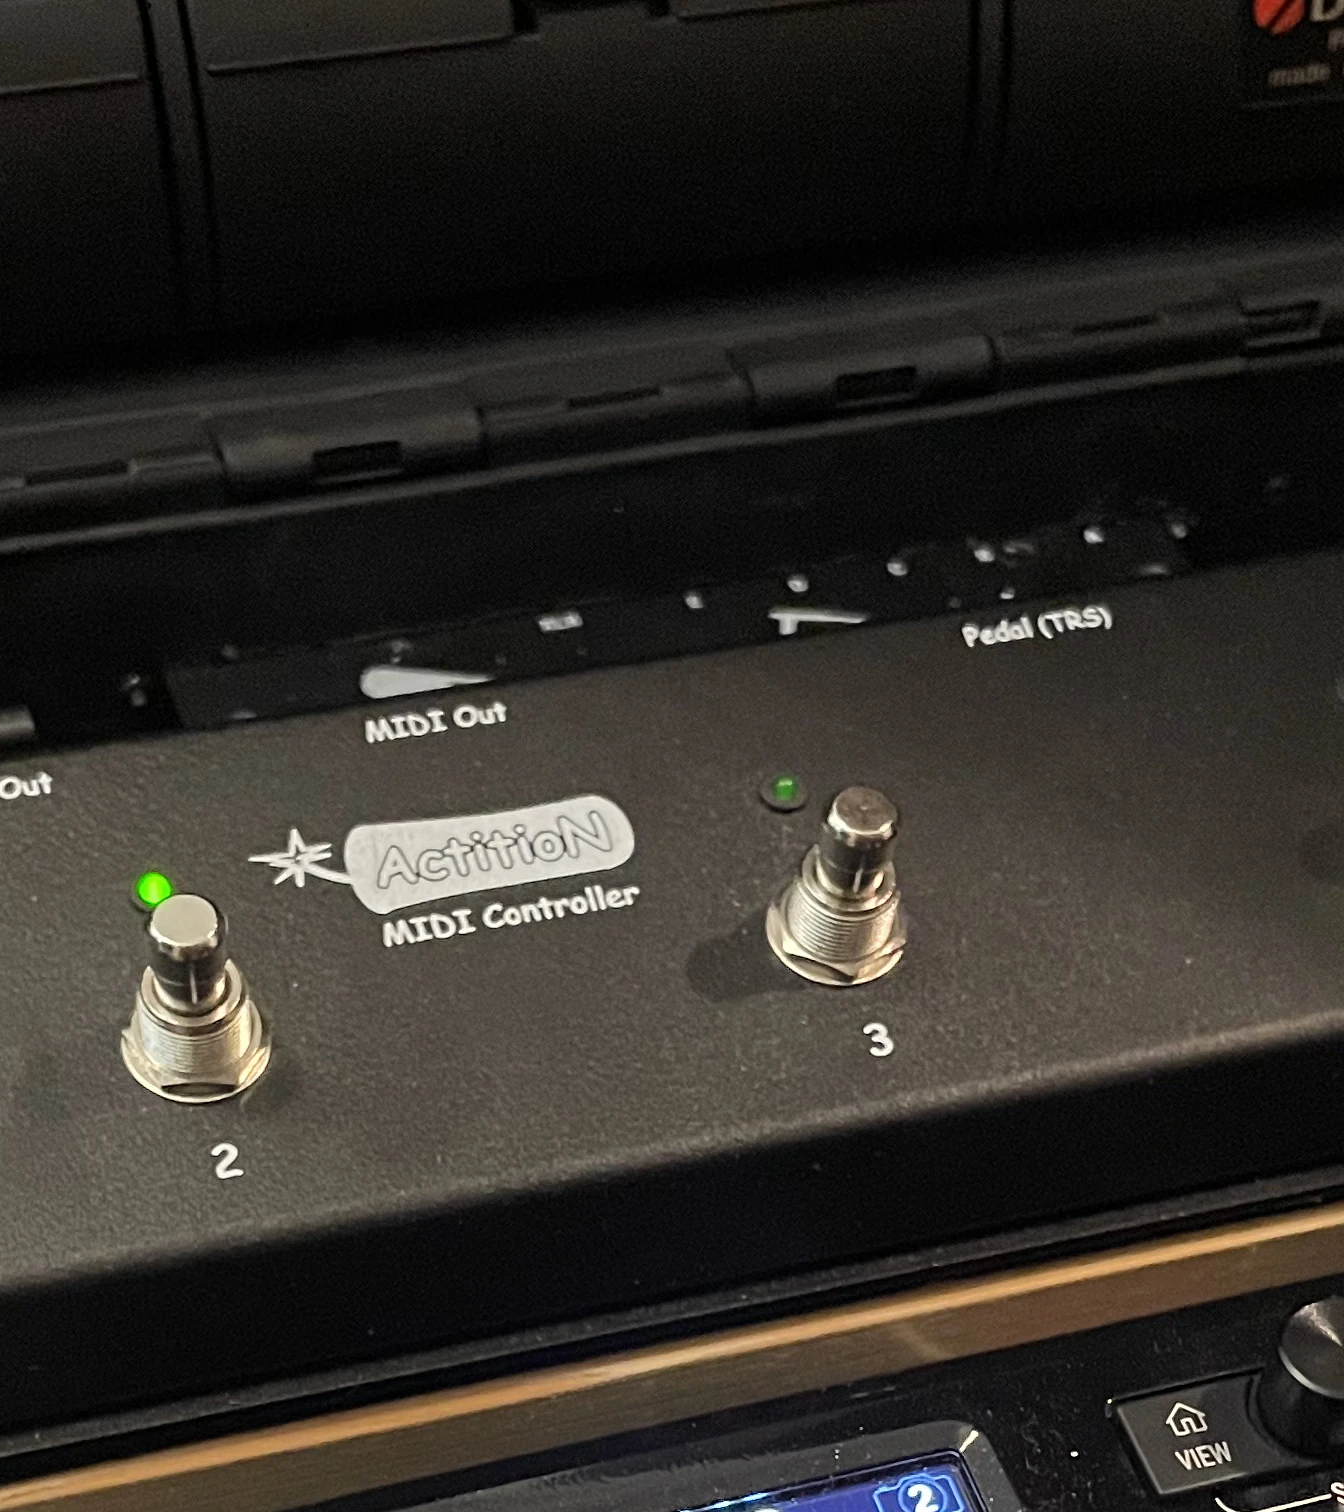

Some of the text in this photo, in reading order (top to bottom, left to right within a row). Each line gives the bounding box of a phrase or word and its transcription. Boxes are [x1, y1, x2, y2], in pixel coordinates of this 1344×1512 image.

[961, 604, 1113, 648] Pedal (TRS)
[364, 701, 508, 745] MIDI Out
[376, 809, 614, 890] ActitioN
[381, 884, 641, 948] MIDI Controller
[862, 1022, 895, 1057] 3
[210, 1142, 244, 1180] 2
[1174, 1441, 1232, 1472] VIEW
